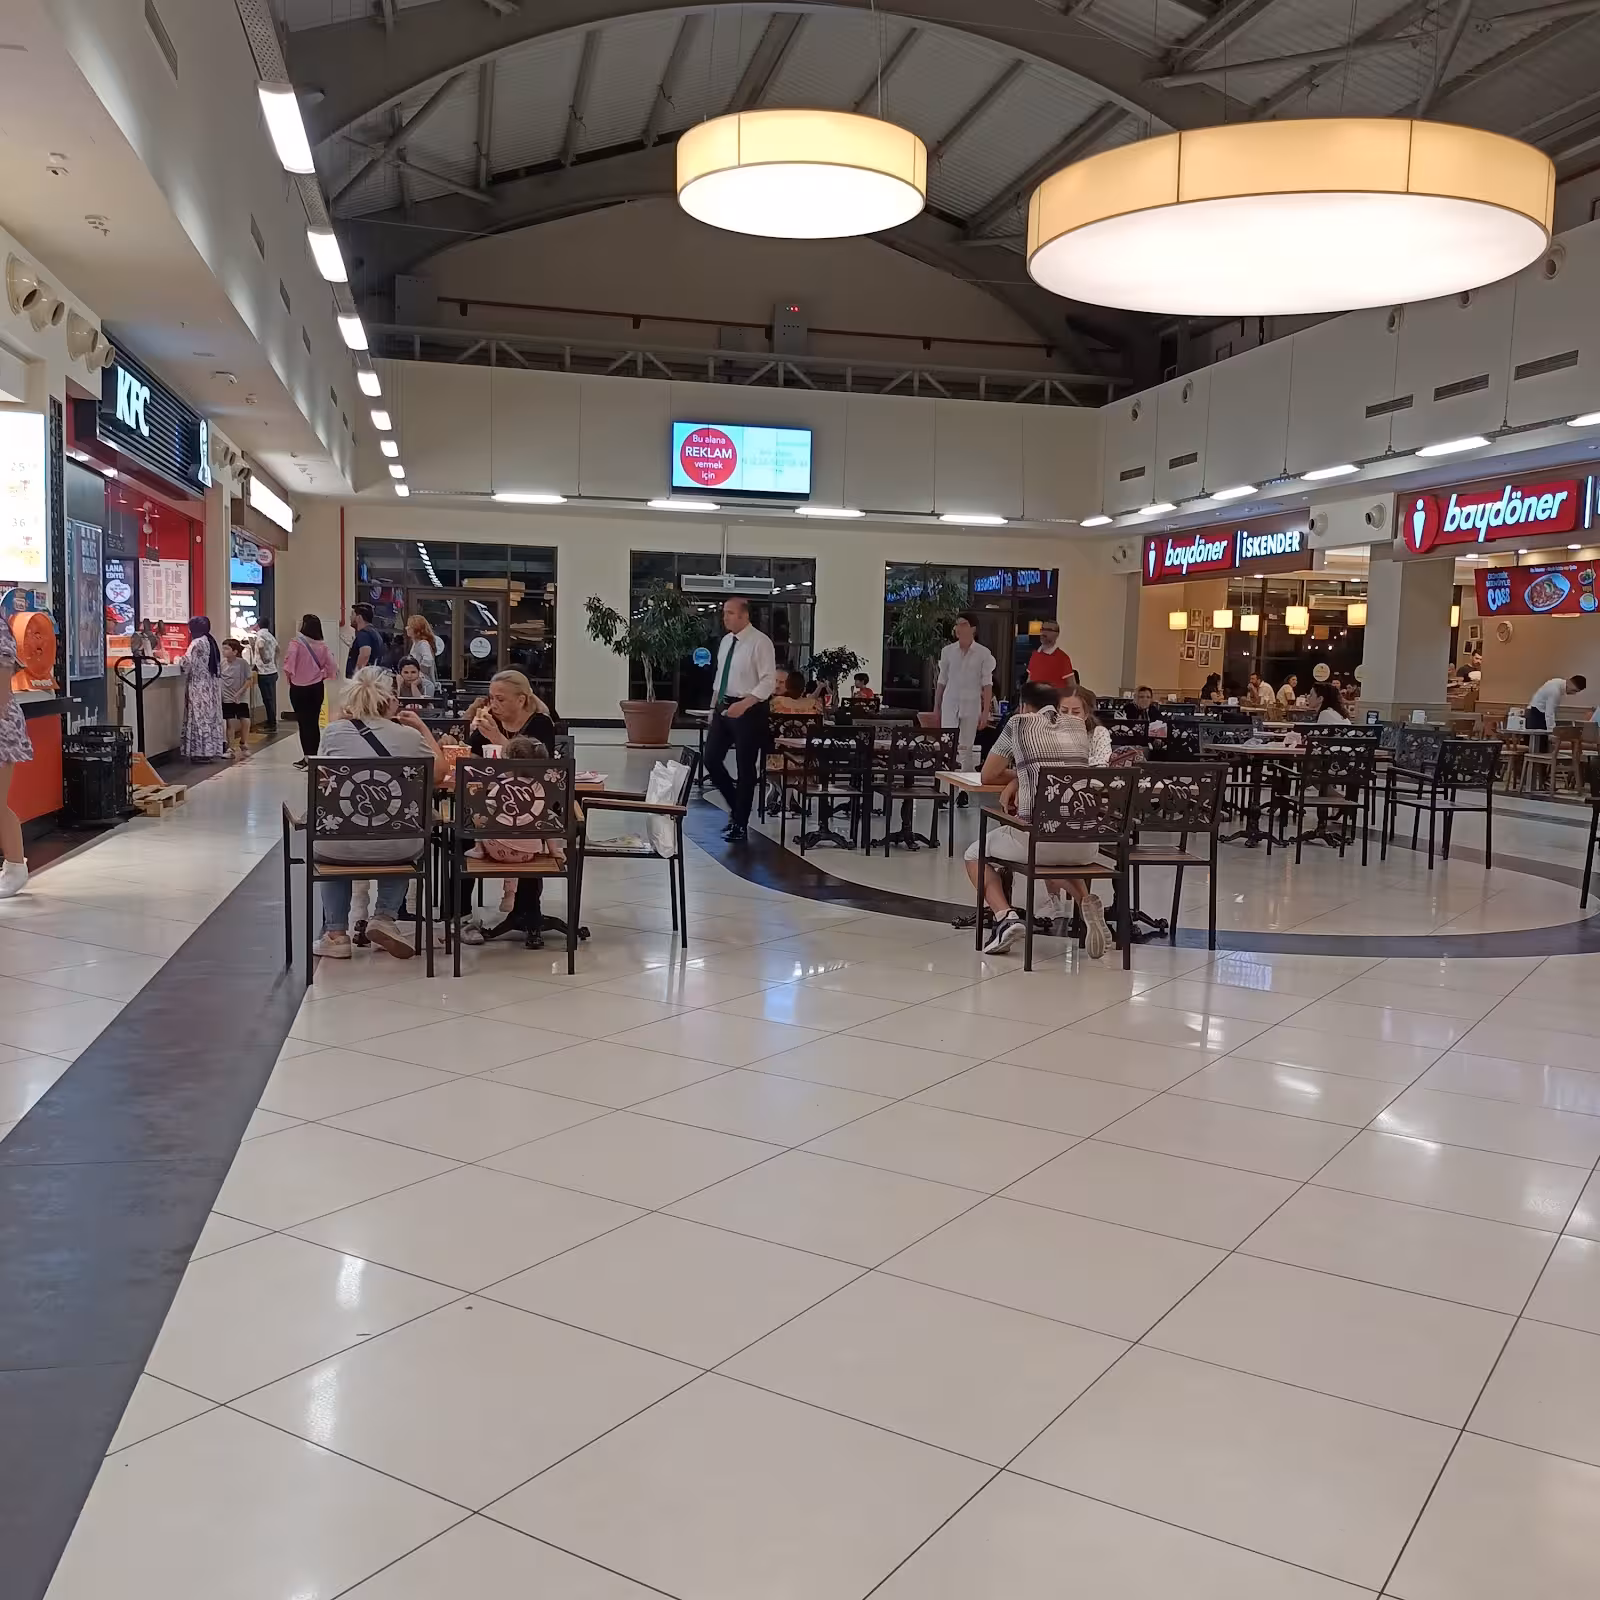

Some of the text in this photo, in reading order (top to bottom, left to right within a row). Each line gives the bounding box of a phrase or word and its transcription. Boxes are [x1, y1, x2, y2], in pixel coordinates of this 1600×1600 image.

[116, 365, 151, 438] KFC
[692, 434, 726, 445] Bu alana
[685, 447, 732, 459] REKLAM
[694, 460, 724, 470] vermek
[702, 471, 715, 480] için
[1443, 484, 1569, 544] baydöner
[1164, 534, 1229, 576] baydöner
